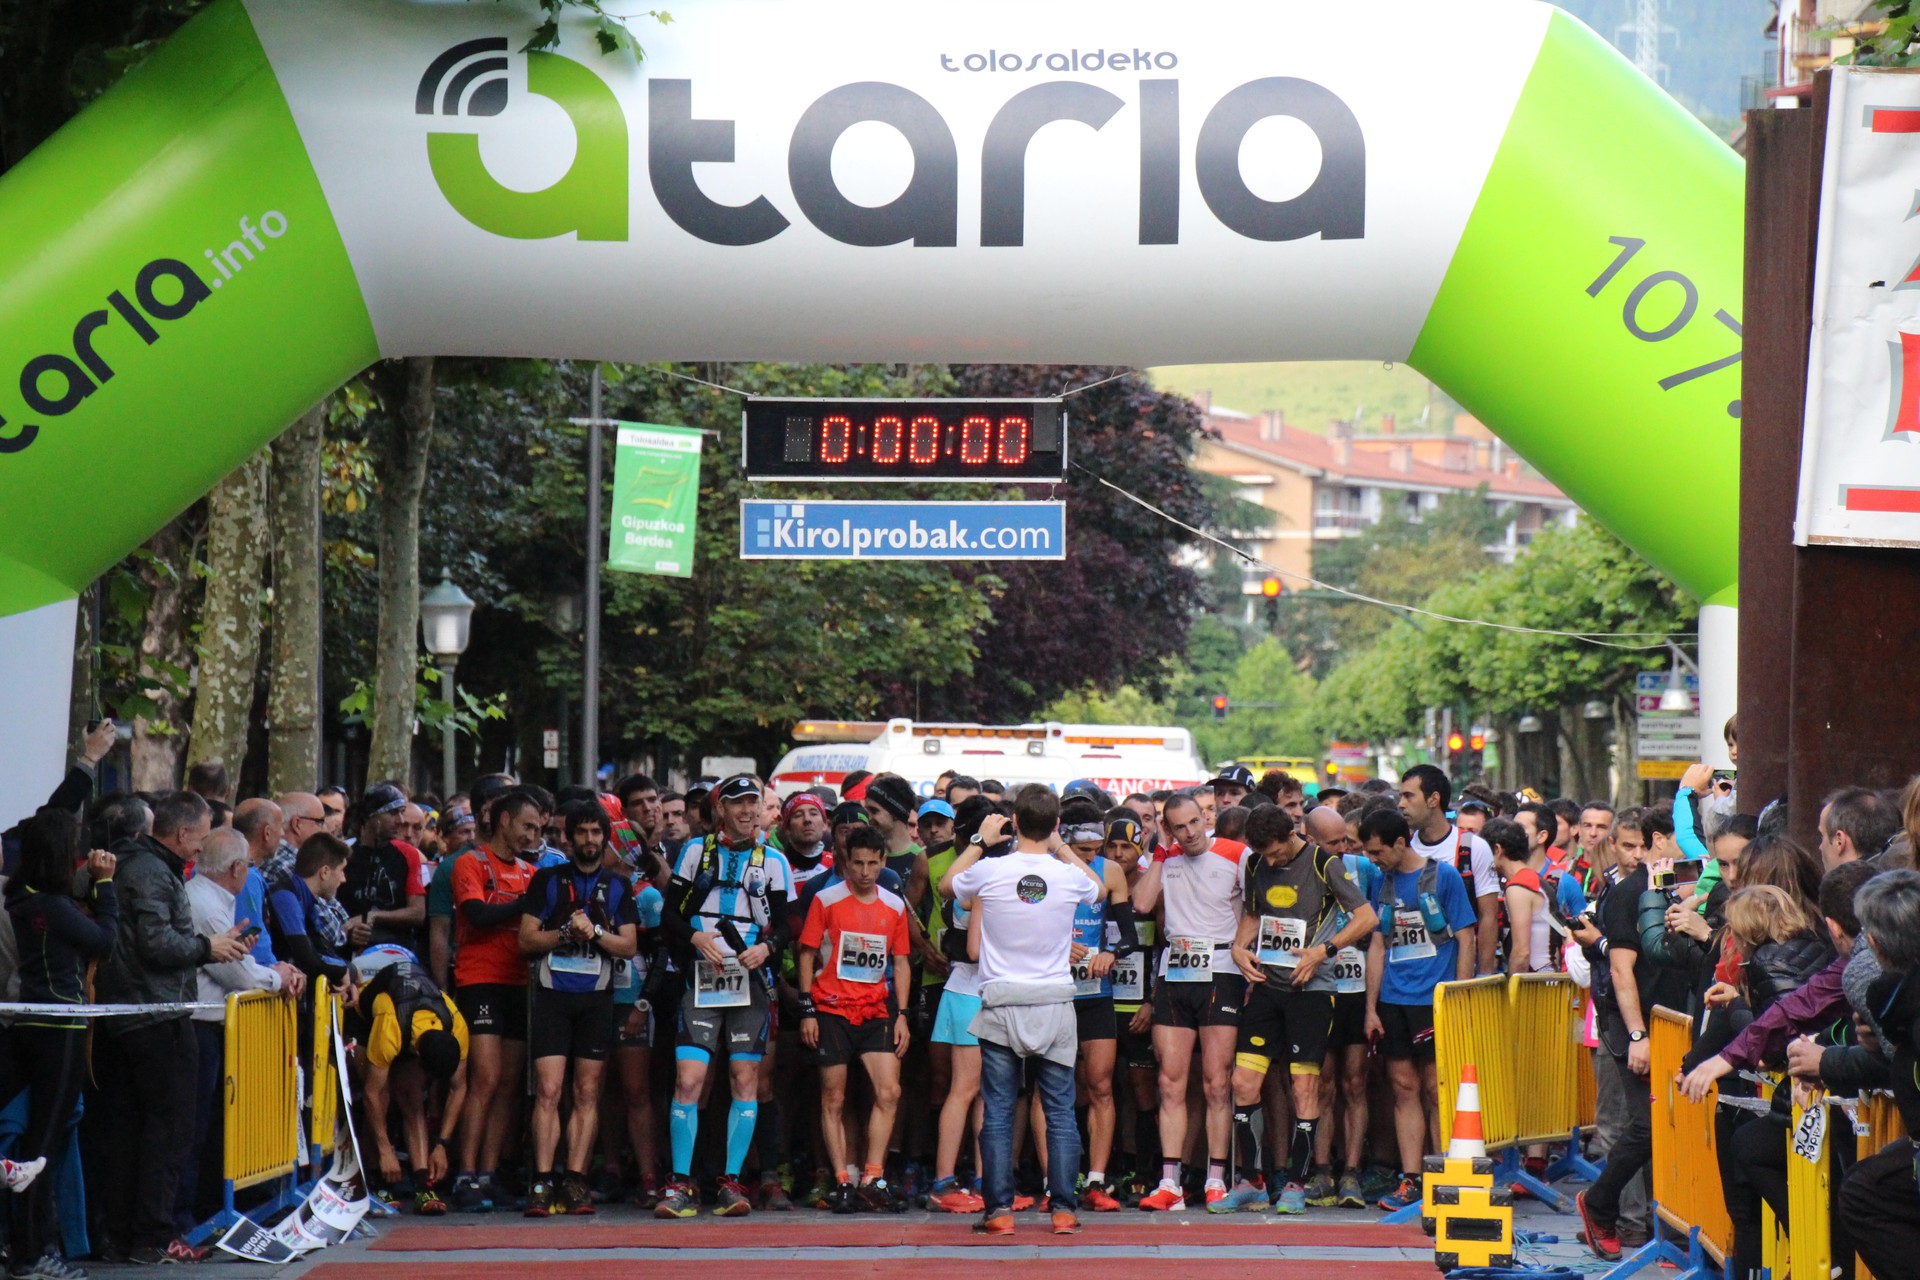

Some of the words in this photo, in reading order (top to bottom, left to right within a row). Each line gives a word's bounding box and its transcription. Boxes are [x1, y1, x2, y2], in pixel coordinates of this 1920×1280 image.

[941, 48, 1178, 73] tolosaldeko
[416, 37, 1365, 247] ataria
[820, 416, 1028, 464] 0:00:00
[621, 514, 686, 534] Gipuzkoa
[624, 531, 673, 550] Berdea
[772, 516, 1051, 557] Kirolprobak.com
[1402, 927, 1427, 946] 181
[857, 952, 885, 969] 005
[1179, 953, 1210, 969] 003
[1334, 963, 1363, 979] 028
